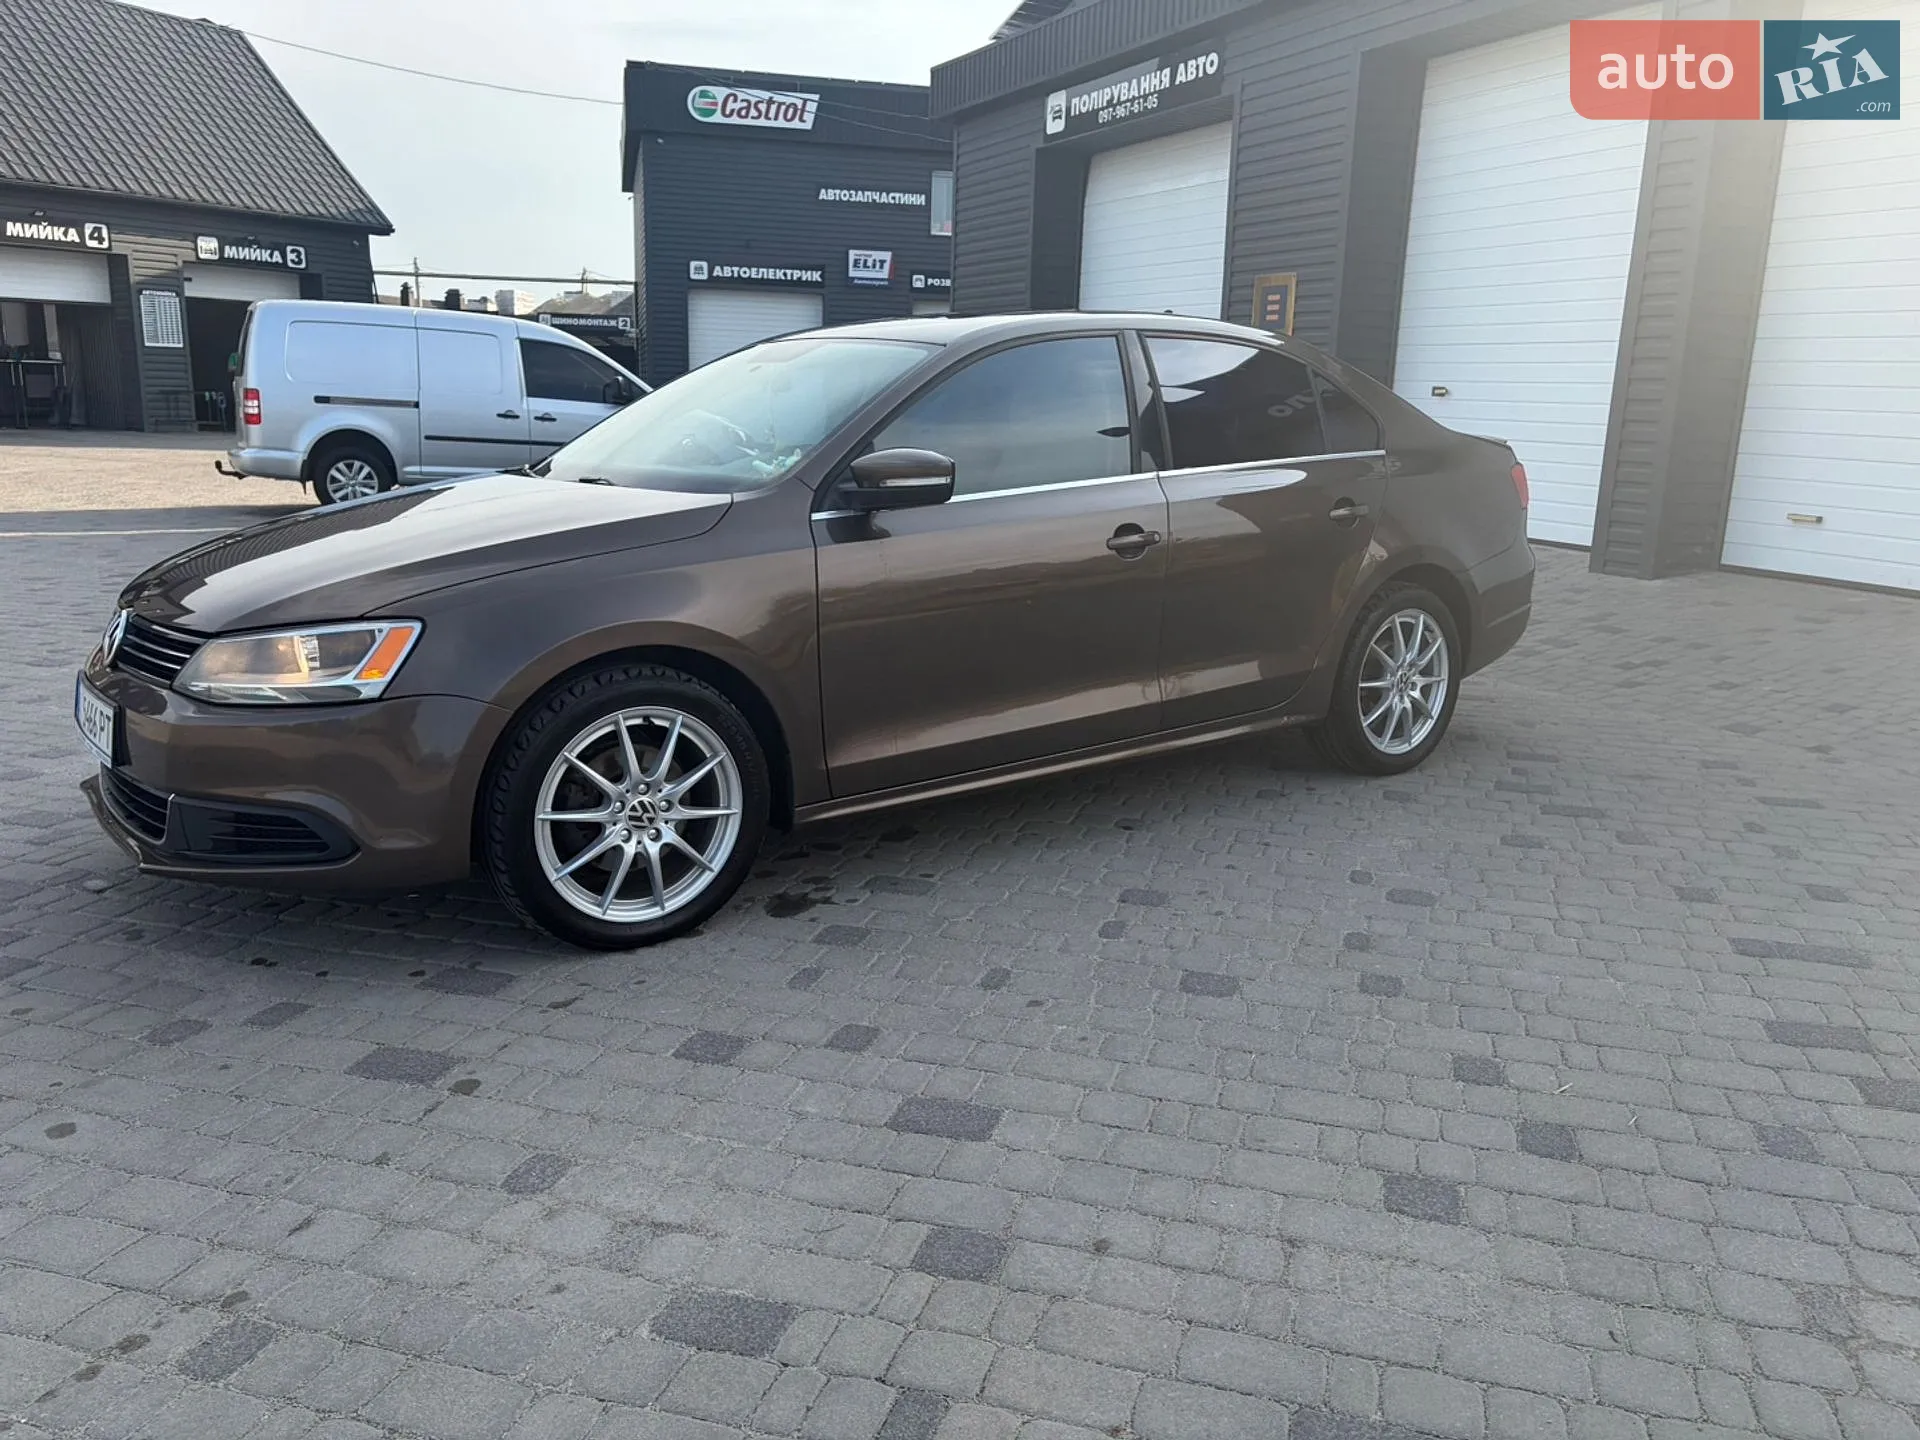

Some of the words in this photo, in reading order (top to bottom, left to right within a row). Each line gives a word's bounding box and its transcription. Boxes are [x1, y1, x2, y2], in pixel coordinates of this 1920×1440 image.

[1070, 67, 1171, 117] ПОЛІРУВАННЯ
[1174, 52, 1219, 86] АВТО
[720, 92, 808, 123] Castrol
[818, 188, 926, 206] АВТОЗАПЧАСТИНИ
[6, 221, 80, 243] МИЙКА
[88, 225, 105, 246] 4
[224, 244, 283, 264] МИЙКА
[290, 248, 303, 266] 3
[712, 265, 823, 282] АВТОЕЛЕКТРИК
[551, 317, 617, 327] ШИНОМОНТАЖ
